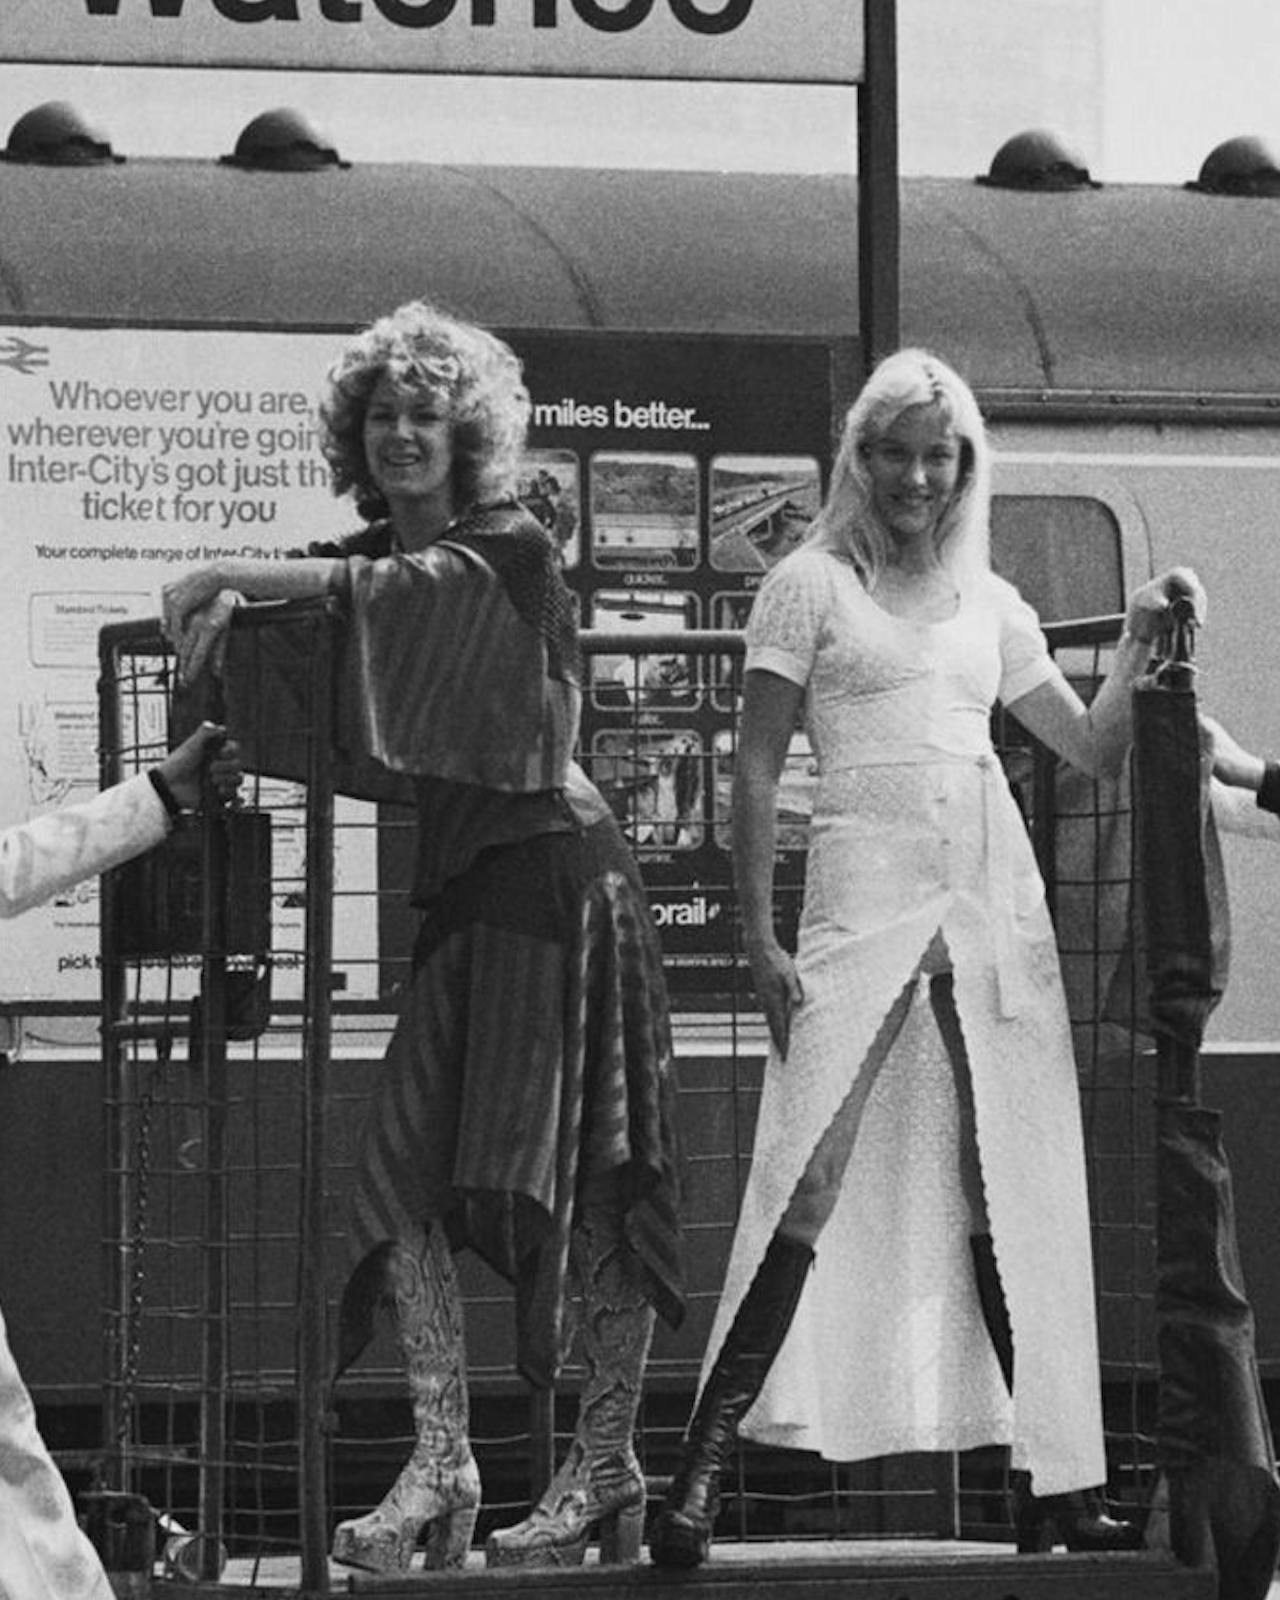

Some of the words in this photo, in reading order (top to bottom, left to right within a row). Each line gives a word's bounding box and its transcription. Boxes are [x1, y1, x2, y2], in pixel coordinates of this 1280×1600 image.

[49, 380, 190, 412] Whoever
[196, 387, 252, 419] you
[259, 390, 315, 417] are,
[534, 397, 609, 428] miles
[614, 399, 710, 430] better...
[8, 417, 152, 448] wherever
[159, 421, 250, 455] you're
[257, 422, 322, 456] goin
[8, 454, 170, 491] Inter-City's
[176, 458, 226, 492] got
[231, 458, 290, 493] just
[298, 458, 329, 488] th
[82, 491, 165, 522] ticket
[173, 494, 215, 522] for
[219, 500, 277, 528] you
[35, 545, 66, 559] Your
[70, 544, 138, 561] complete
[141, 547, 182, 563] range
[186, 545, 200, 560] of
[58, 953, 93, 973] pick
